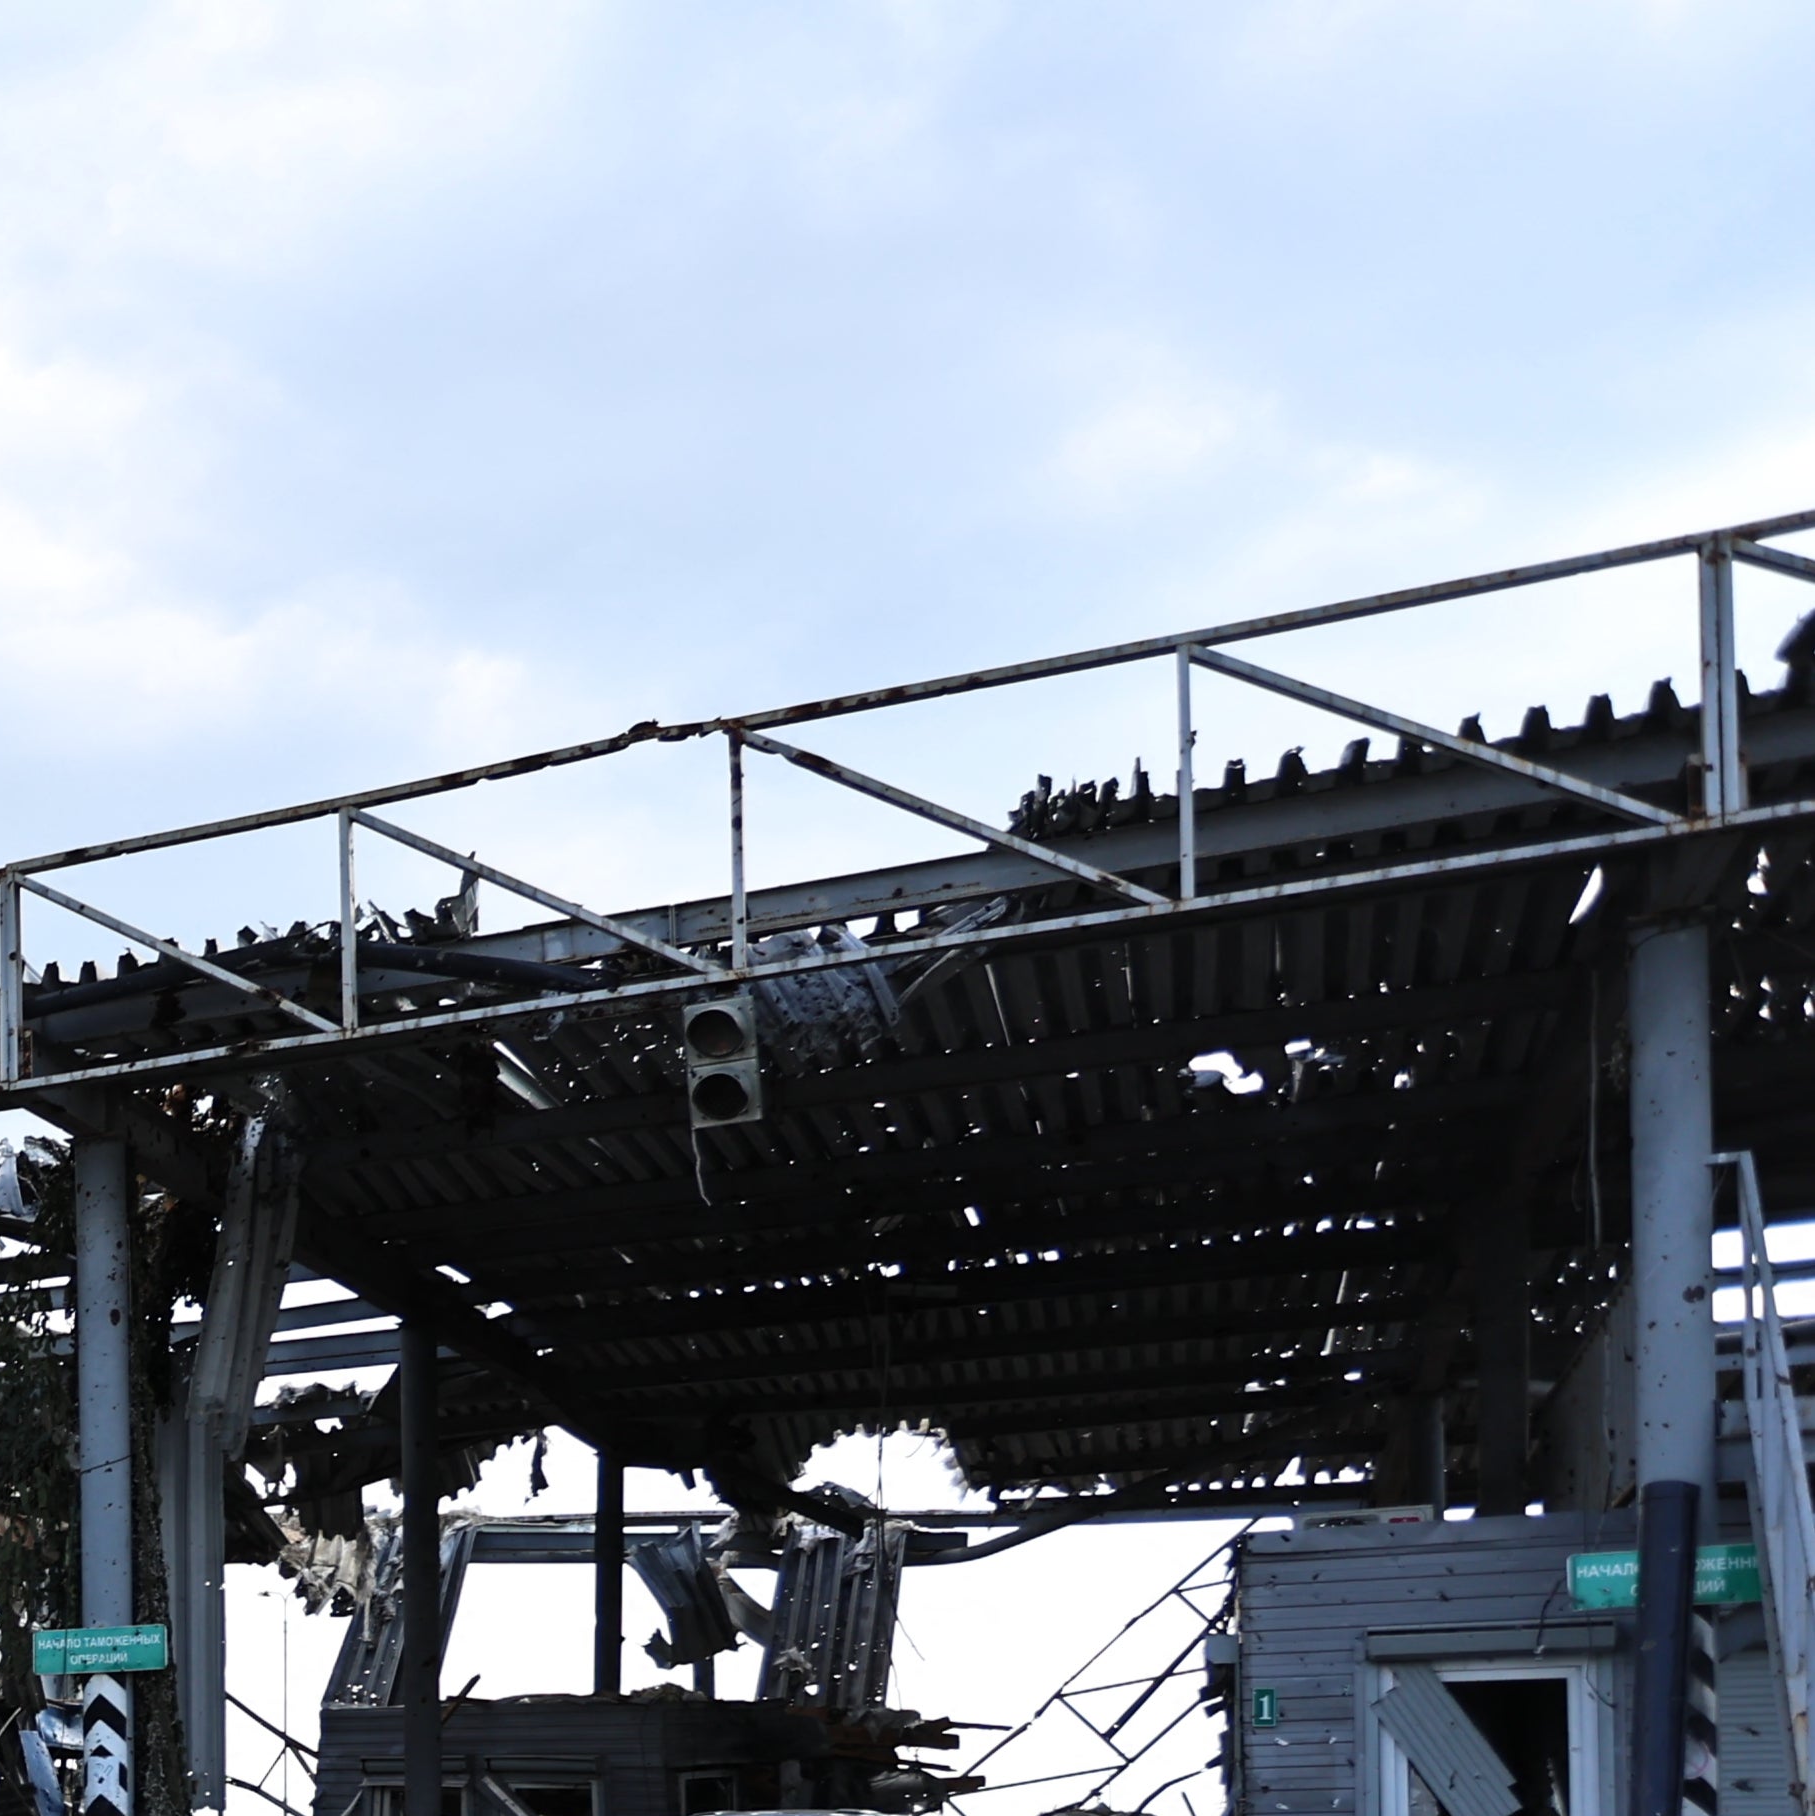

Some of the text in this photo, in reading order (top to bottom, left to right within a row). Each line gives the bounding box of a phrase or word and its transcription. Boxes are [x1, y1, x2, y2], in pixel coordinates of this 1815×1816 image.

[37, 1634, 161, 1650] НАЧАЛО ТАМОЖЕННЫХ
[1258, 1695, 1272, 1720] 1
